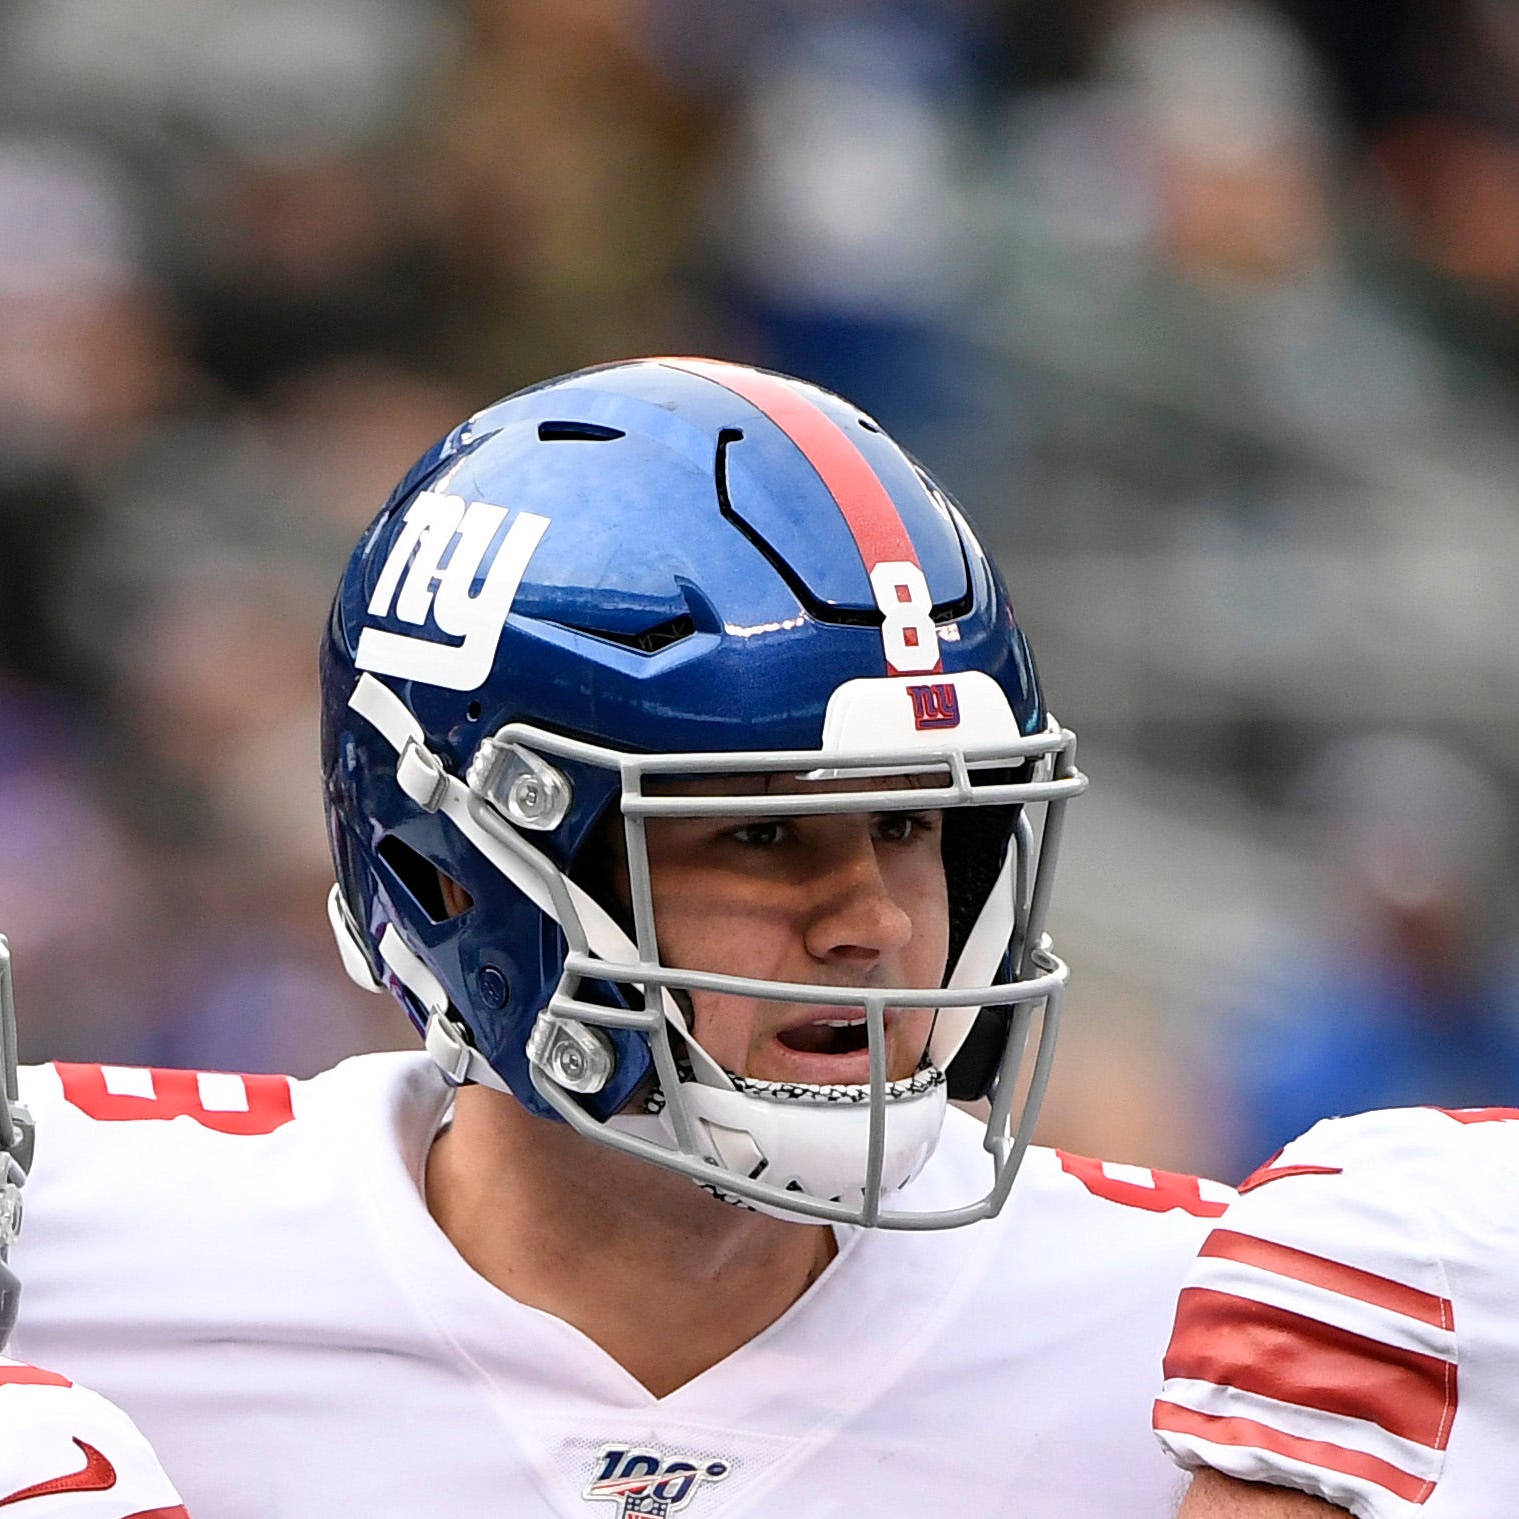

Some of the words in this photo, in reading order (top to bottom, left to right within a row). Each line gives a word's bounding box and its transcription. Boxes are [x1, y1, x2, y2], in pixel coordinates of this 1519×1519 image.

[355, 491, 552, 691] ny
[869, 560, 942, 672] 8
[906, 683, 961, 732] ny
